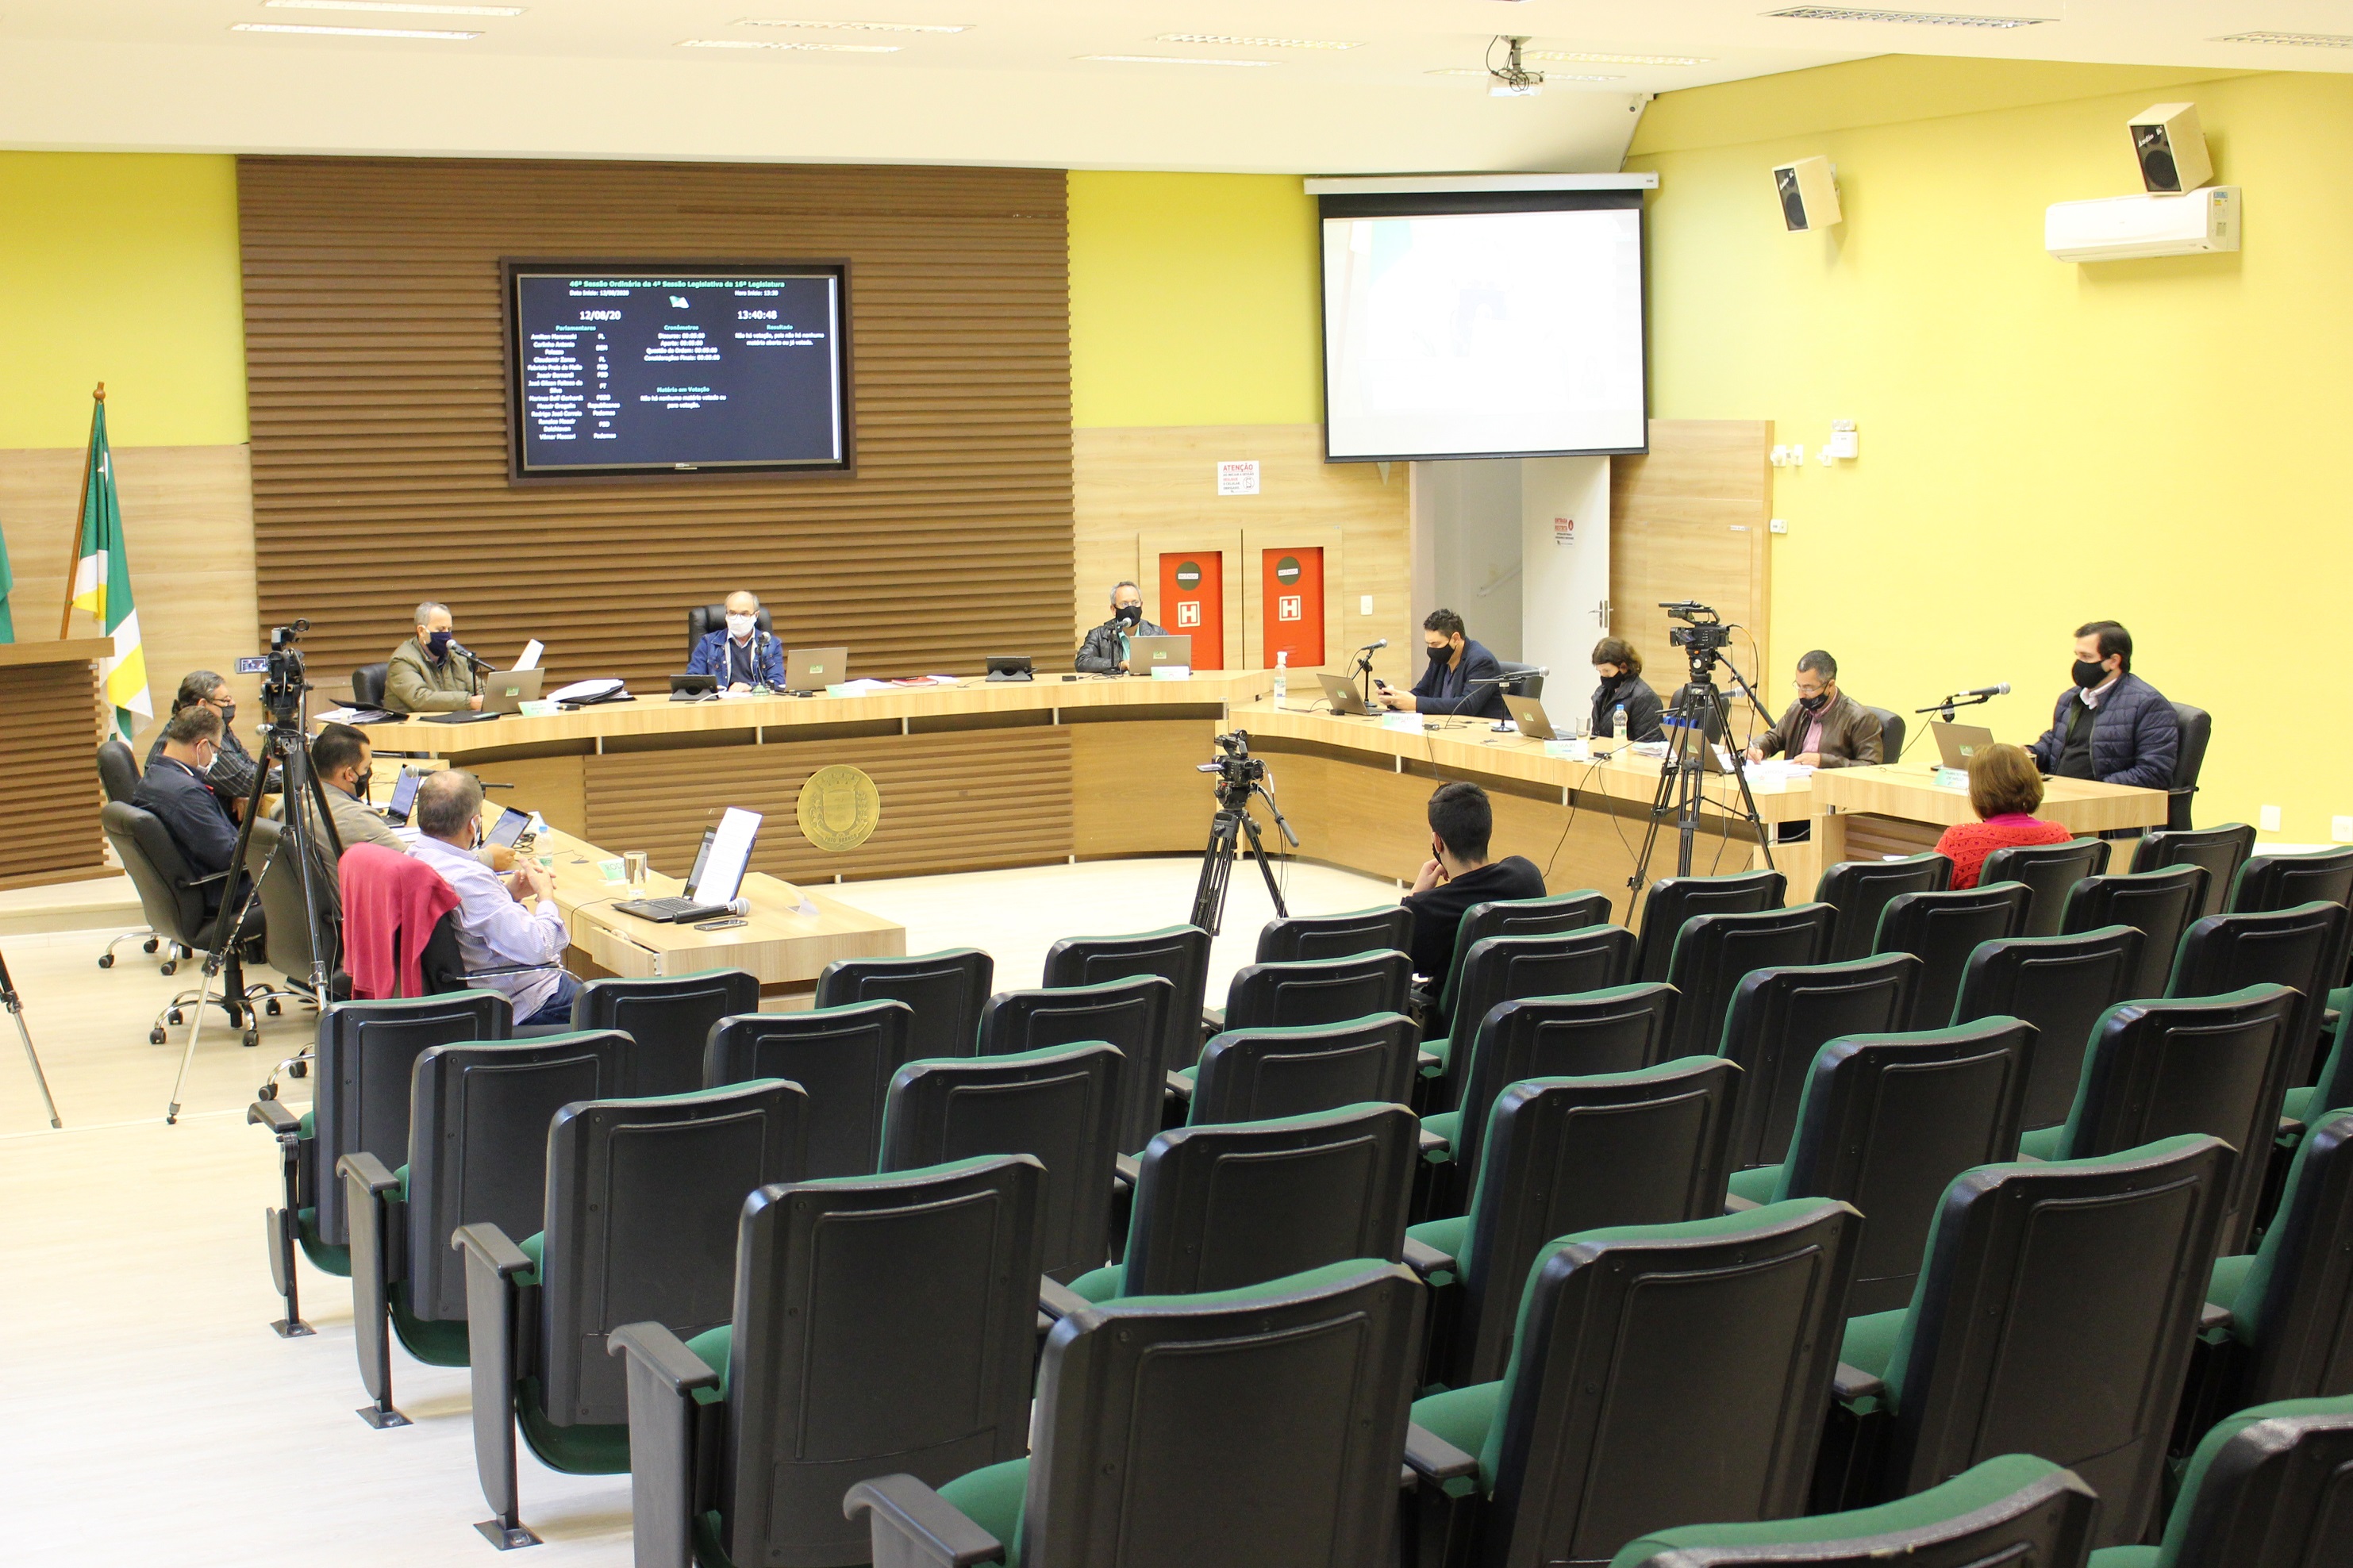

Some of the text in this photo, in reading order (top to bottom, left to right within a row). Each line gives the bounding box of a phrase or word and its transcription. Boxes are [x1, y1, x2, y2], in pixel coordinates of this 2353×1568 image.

[580, 311, 621, 321] 12/08/20
[738, 310, 777, 319] 13:40:48
[1223, 463, 1253, 472] ATENÇÃO
[1282, 600, 1298, 617] H
[1181, 605, 1197, 624] H
